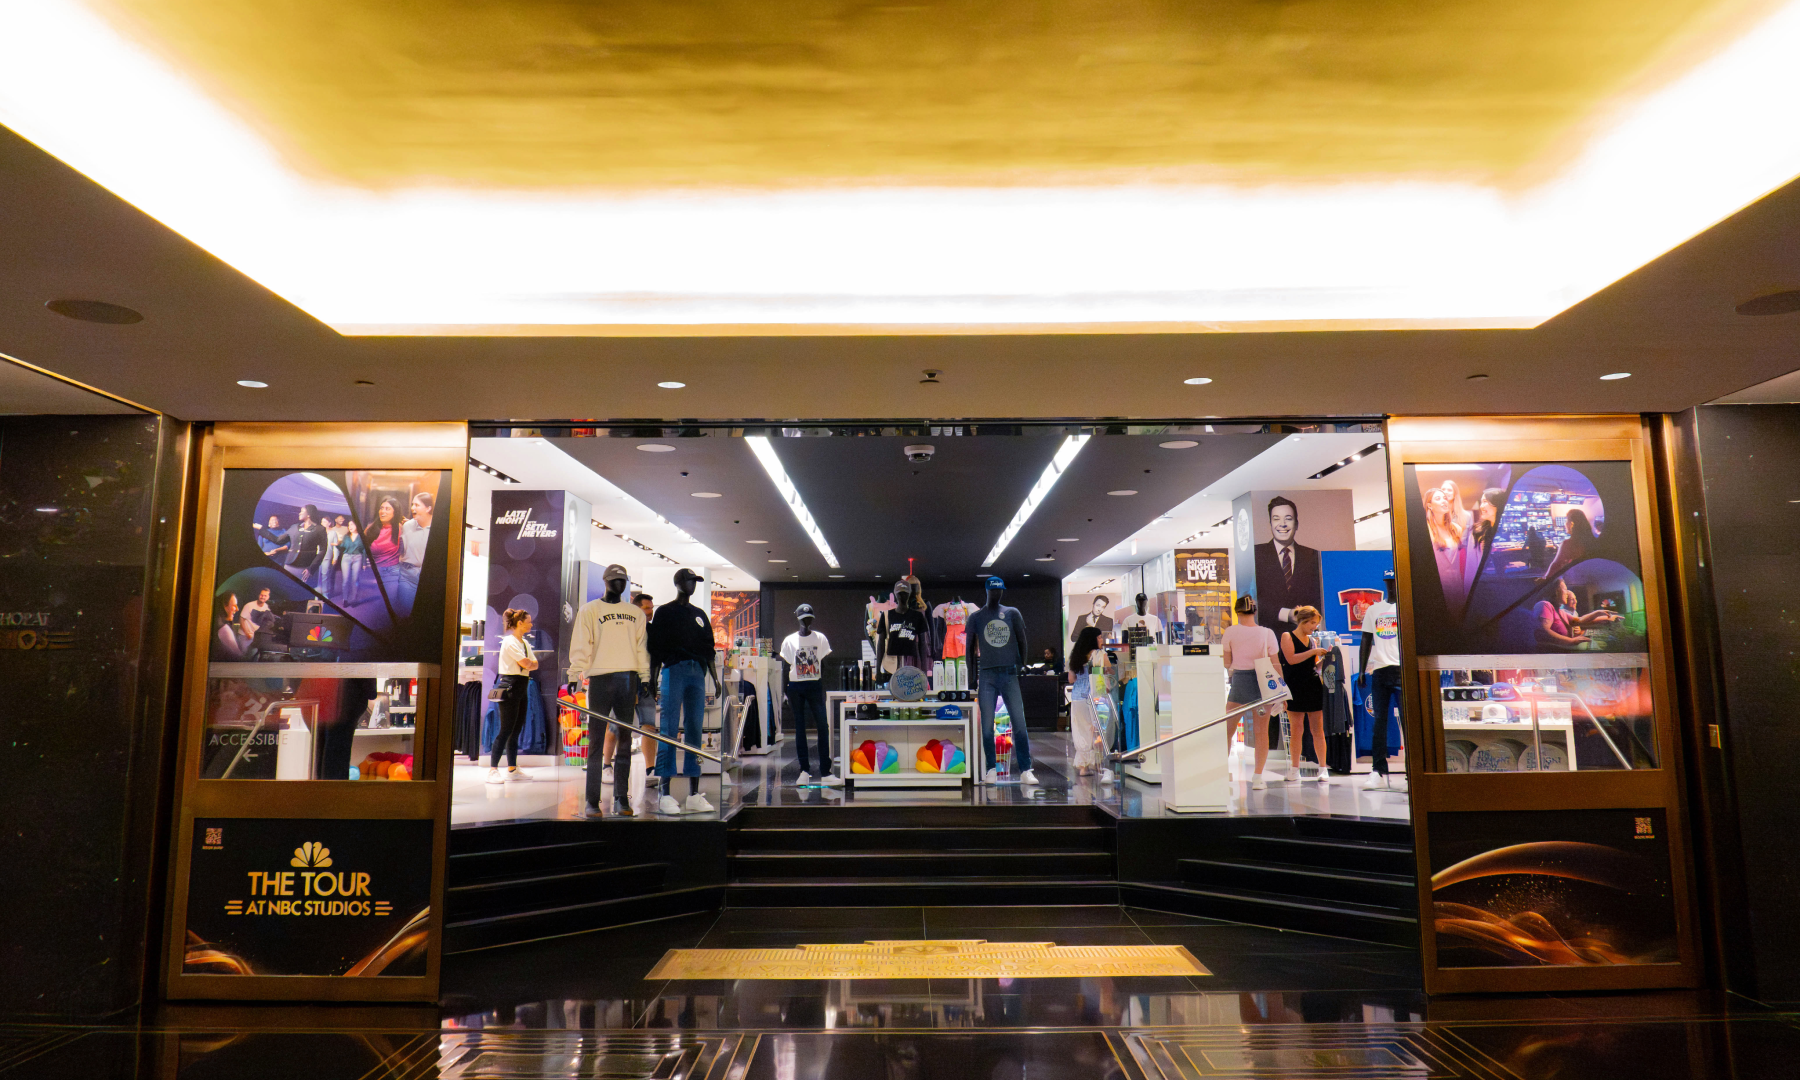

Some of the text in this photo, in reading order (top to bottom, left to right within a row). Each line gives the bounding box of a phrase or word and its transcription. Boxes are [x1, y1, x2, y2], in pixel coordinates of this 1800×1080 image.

[504, 510, 528, 518] LATE
[495, 516, 526, 525] NIGHT
[525, 523, 548, 531] SETH
[522, 530, 558, 538] MEYERS
[1187, 563, 1217, 571] NIGHT
[1187, 570, 1218, 581] LIVE
[598, 612, 637, 625] LATE NIGHT
[208, 733, 289, 746] ACCESSIBLE
[247, 871, 372, 897] THE TOUR
[245, 900, 372, 916] AT NBC STUDIOS
